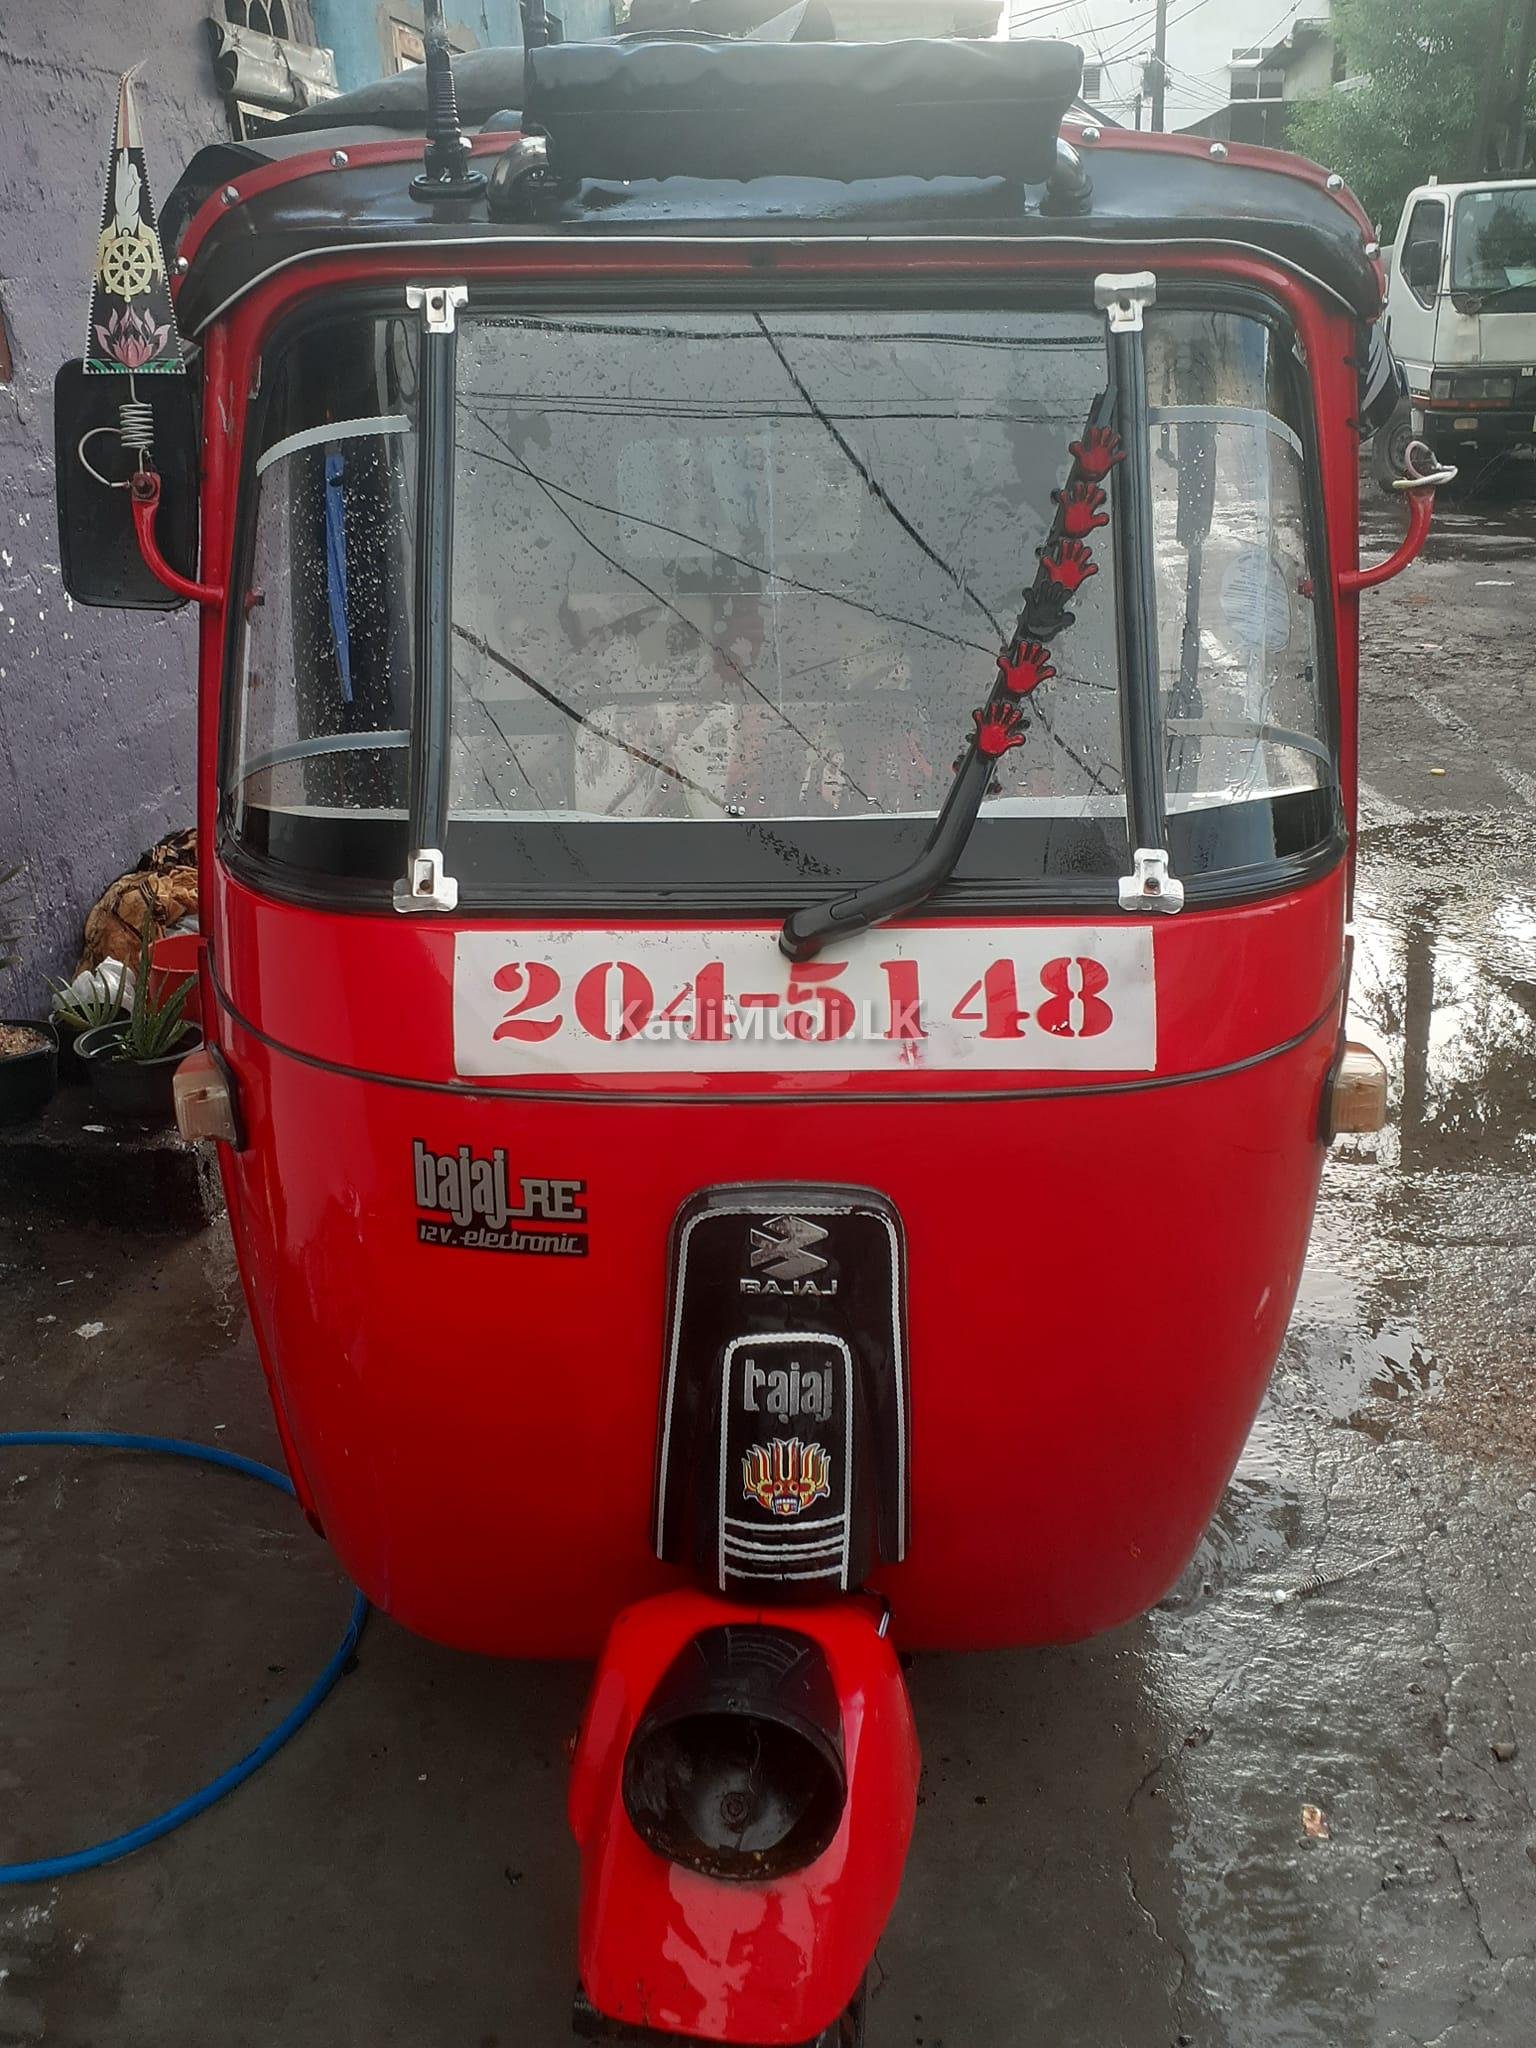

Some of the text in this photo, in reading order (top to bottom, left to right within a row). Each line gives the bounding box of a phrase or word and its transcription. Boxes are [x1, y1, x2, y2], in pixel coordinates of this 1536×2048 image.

[1521, 367, 1536, 377] M
[492, 956, 1113, 1043] 204-5148
[413, 1140, 582, 1230] bajaj RE
[460, 1228, 583, 1254] electronic
[739, 1278, 838, 1295] BAJAJ
